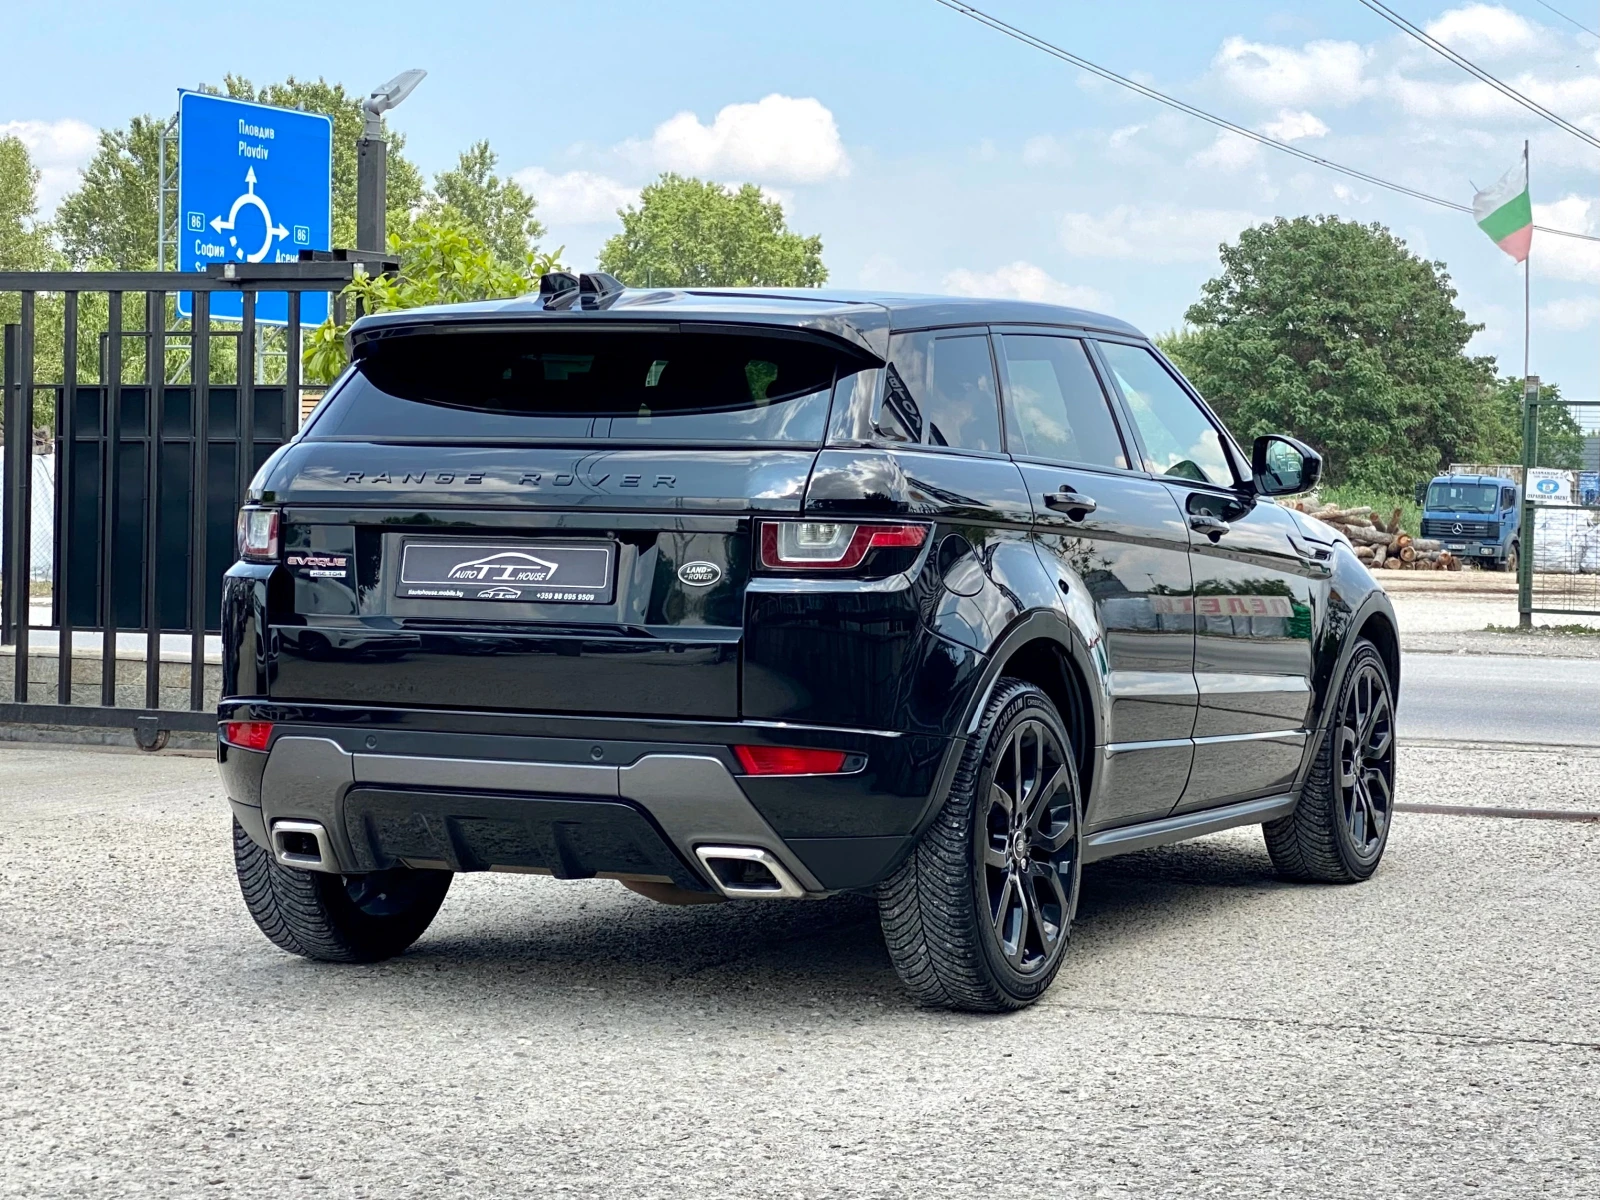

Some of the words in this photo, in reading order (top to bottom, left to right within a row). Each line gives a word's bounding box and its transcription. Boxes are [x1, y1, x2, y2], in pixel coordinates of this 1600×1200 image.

[238, 118, 275, 140] Пловдив
[238, 140, 269, 160] Plovdiv
[191, 216, 201, 228] 86
[297, 228, 307, 241] 86
[195, 239, 225, 258] София
[343, 469, 487, 485] RANGE
[518, 473, 677, 489] ROVER
[287, 556, 347, 567] EVOQUE
[453, 570, 477, 579] AUTO
[516, 572, 547, 581] HOUSE
[686, 566, 707, 574] LAND
[577, 593, 595, 601] 9509
[991, 697, 1023, 748] MICHELIN
